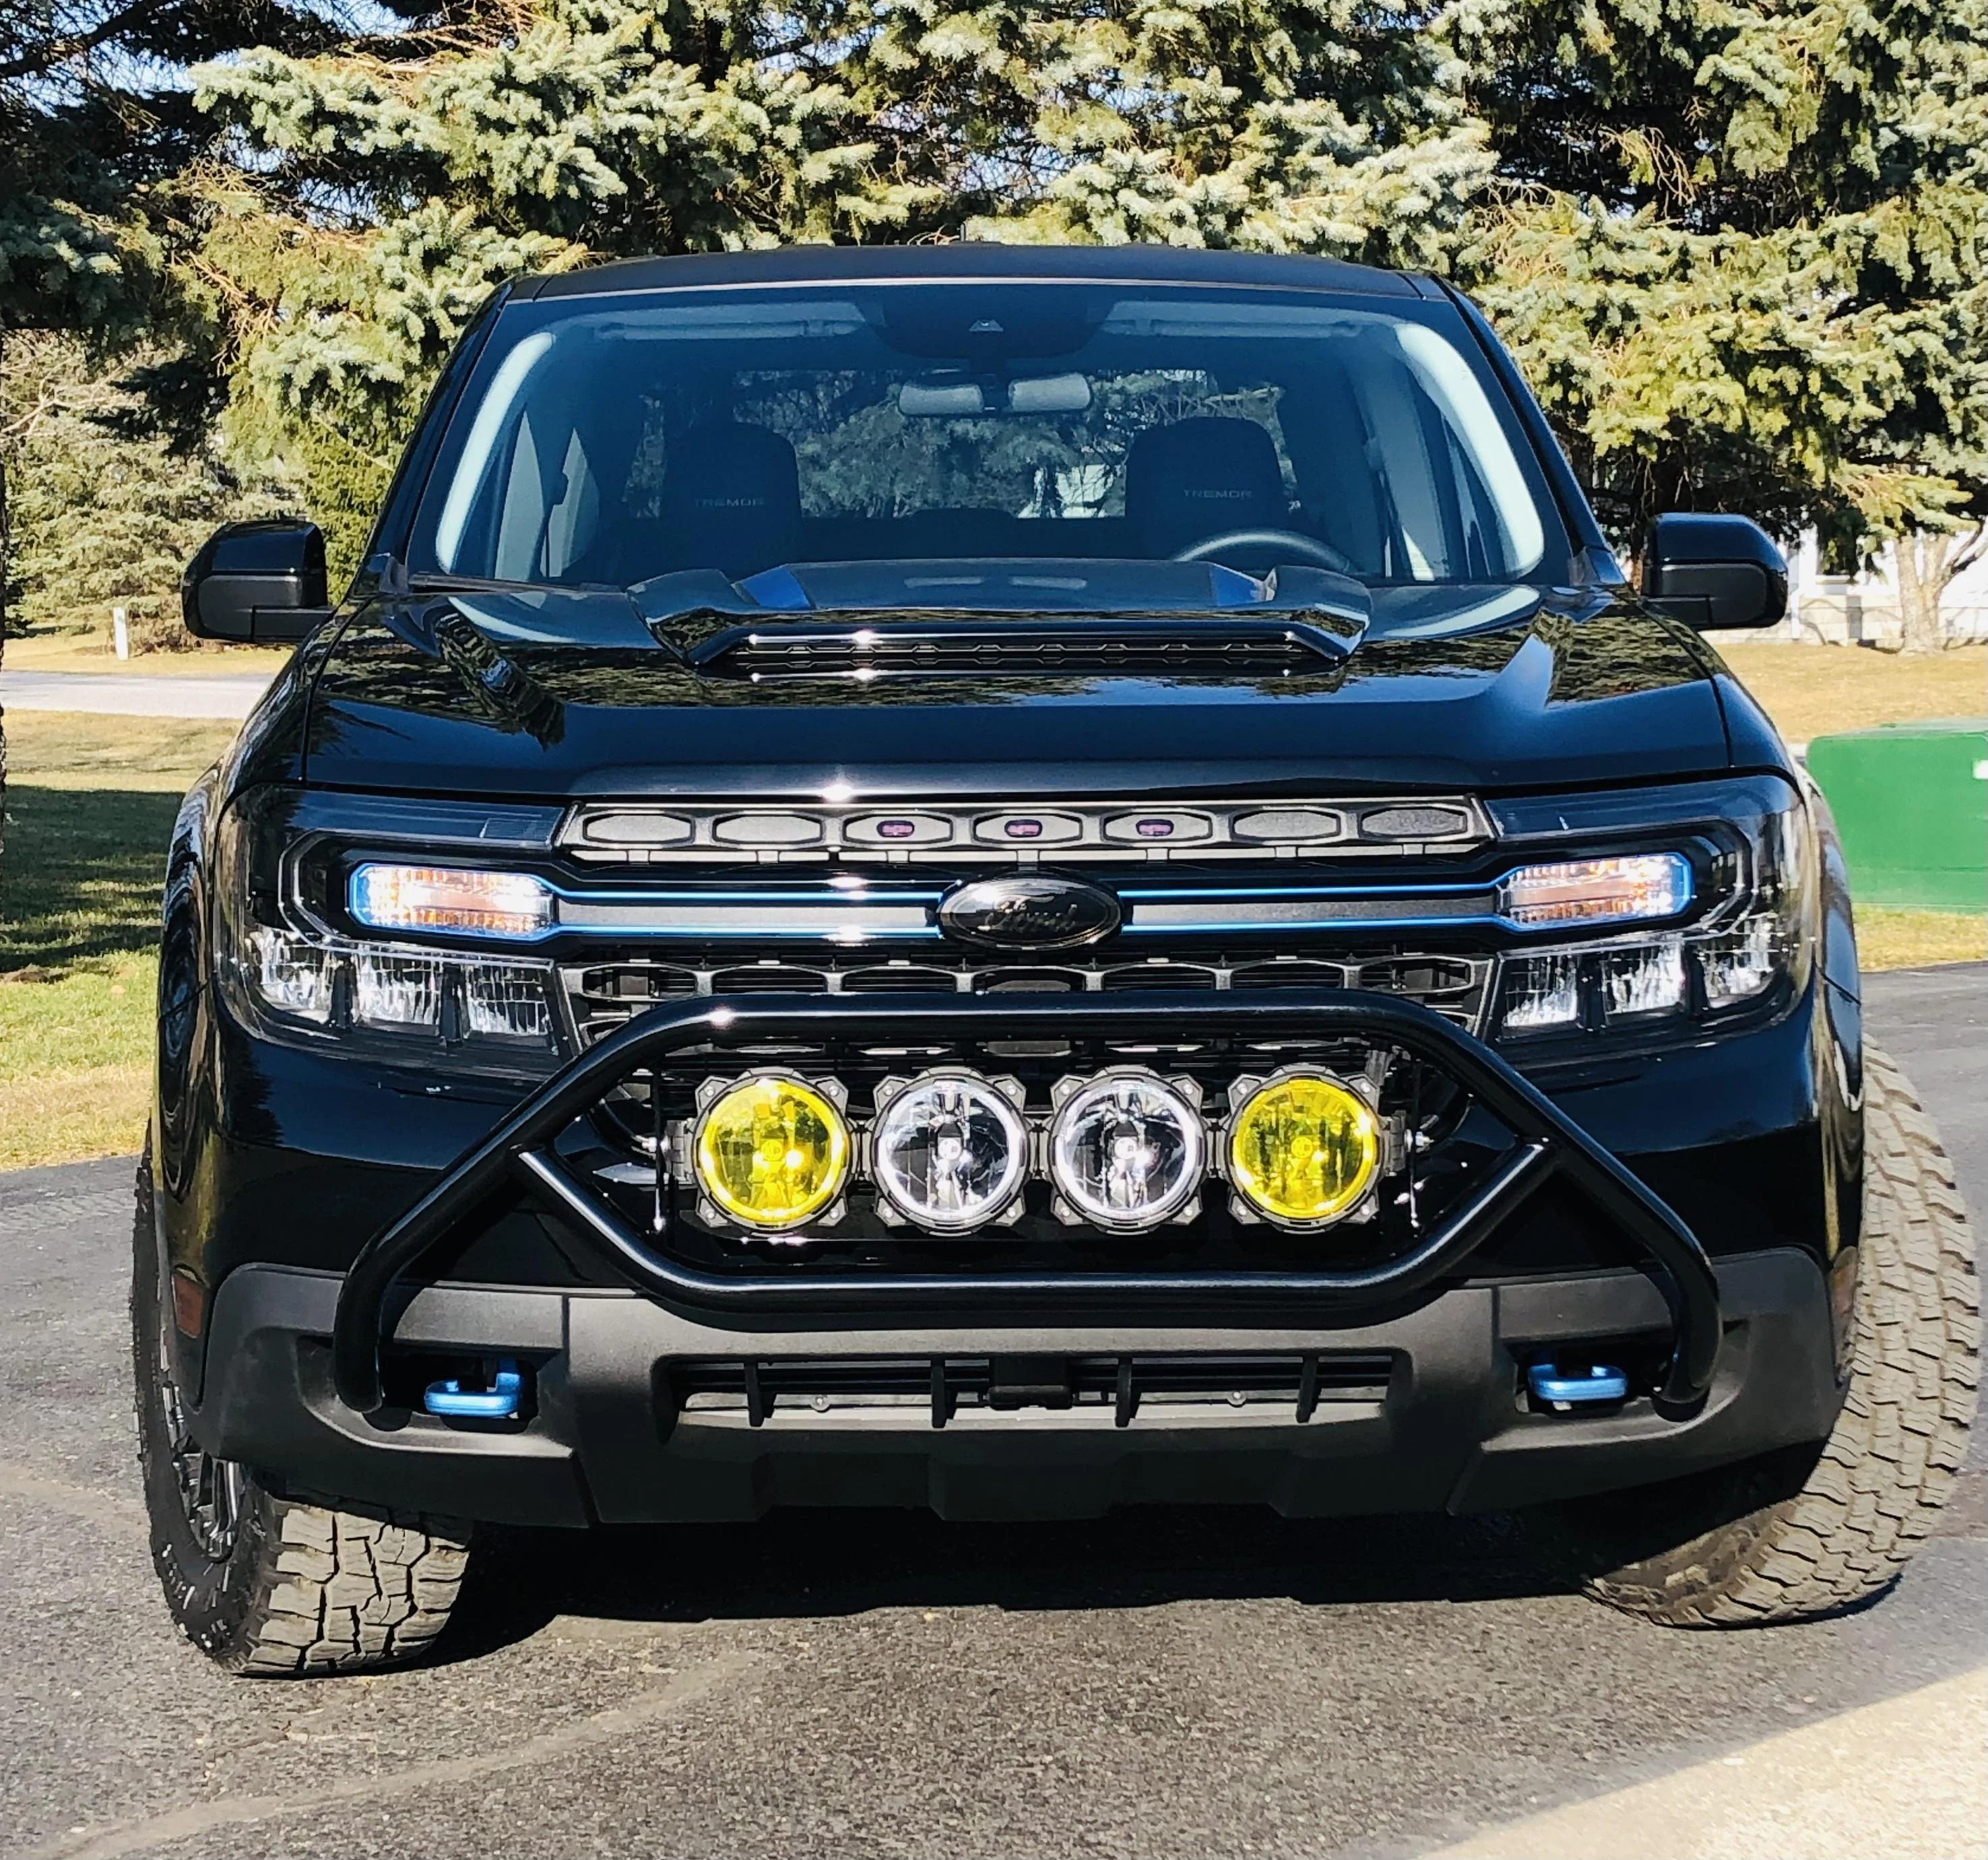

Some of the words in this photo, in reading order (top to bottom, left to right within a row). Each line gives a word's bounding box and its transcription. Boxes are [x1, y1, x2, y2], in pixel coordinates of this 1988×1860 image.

[1183, 489, 1253, 499] TREMOR
[695, 498, 765, 507] TREMOR
[977, 894, 1077, 933] Ford
